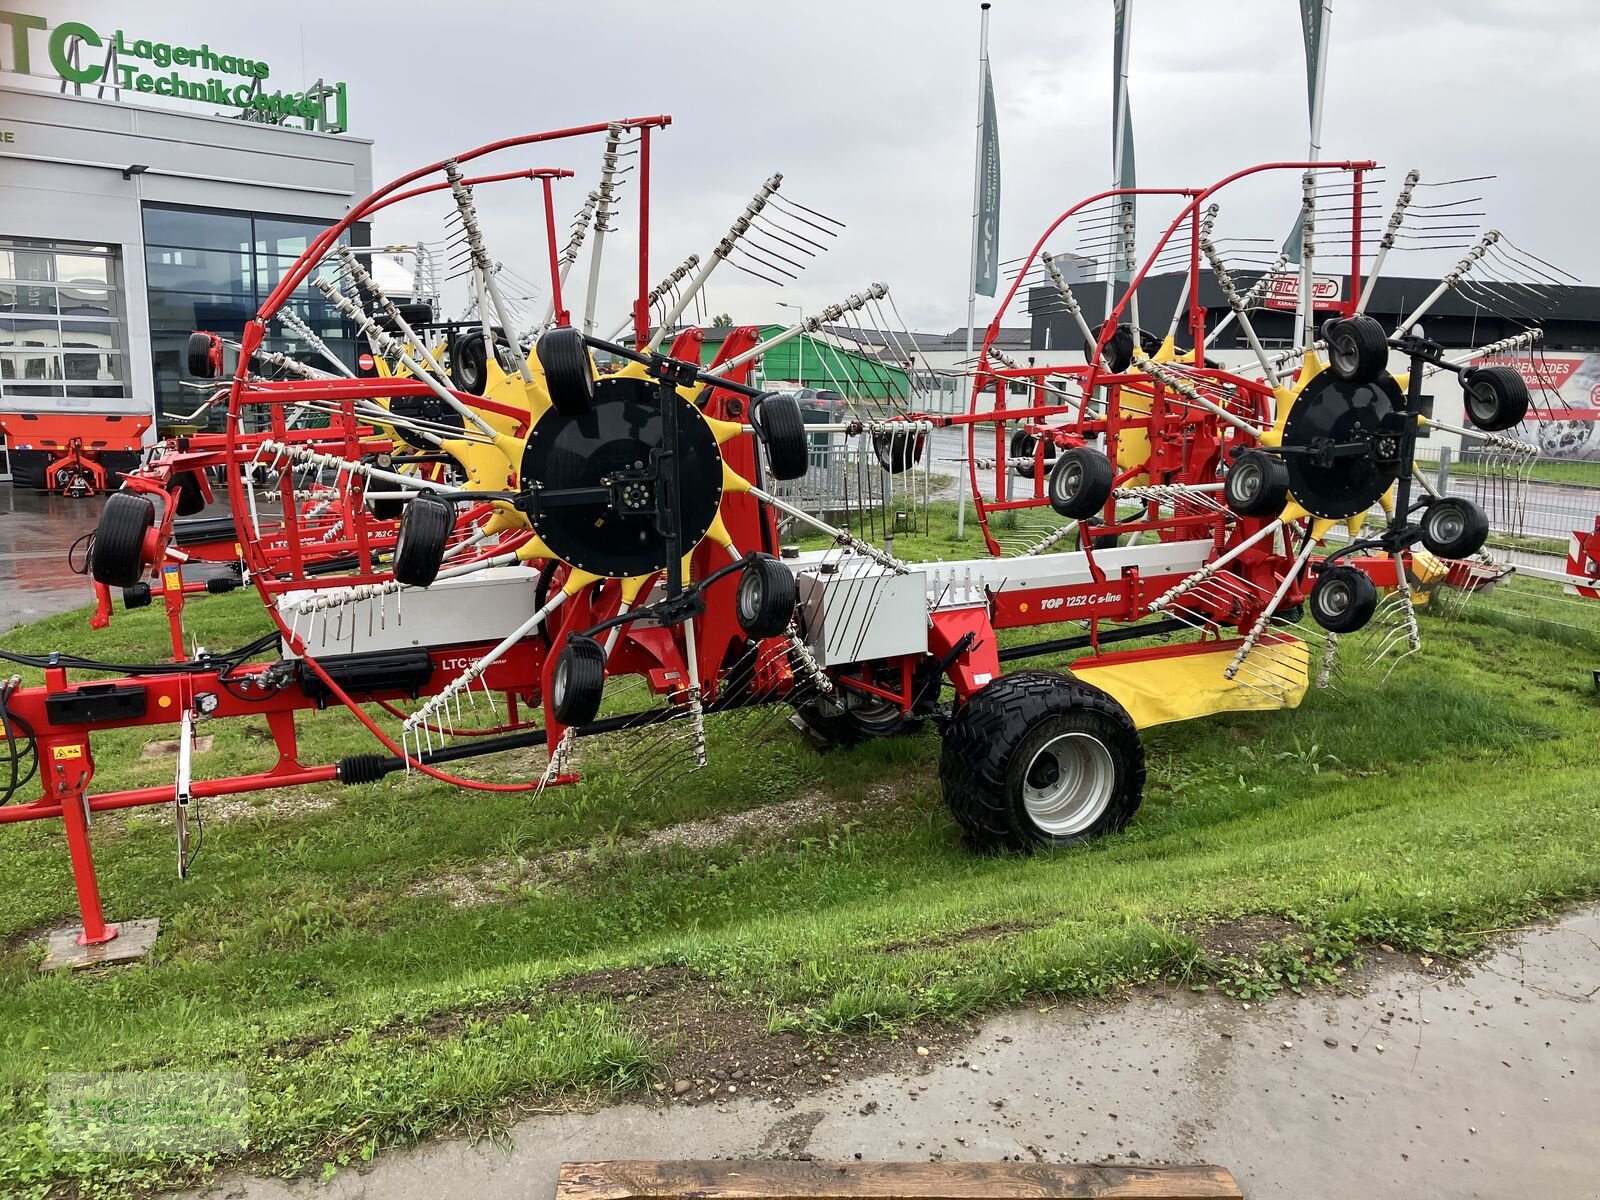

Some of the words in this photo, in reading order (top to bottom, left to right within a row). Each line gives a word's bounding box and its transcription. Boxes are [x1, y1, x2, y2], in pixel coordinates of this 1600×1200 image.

[0, 10, 104, 84] TC
[115, 30, 269, 79] Lagerhaus
[117, 64, 321, 119] TechnikCenter
[1041, 597, 1064, 610] TOP
[1066, 595, 1087, 607] 1252
[1088, 594, 1097, 604] C
[1097, 592, 1122, 604] s-line
[442, 658, 467, 670] LTC
